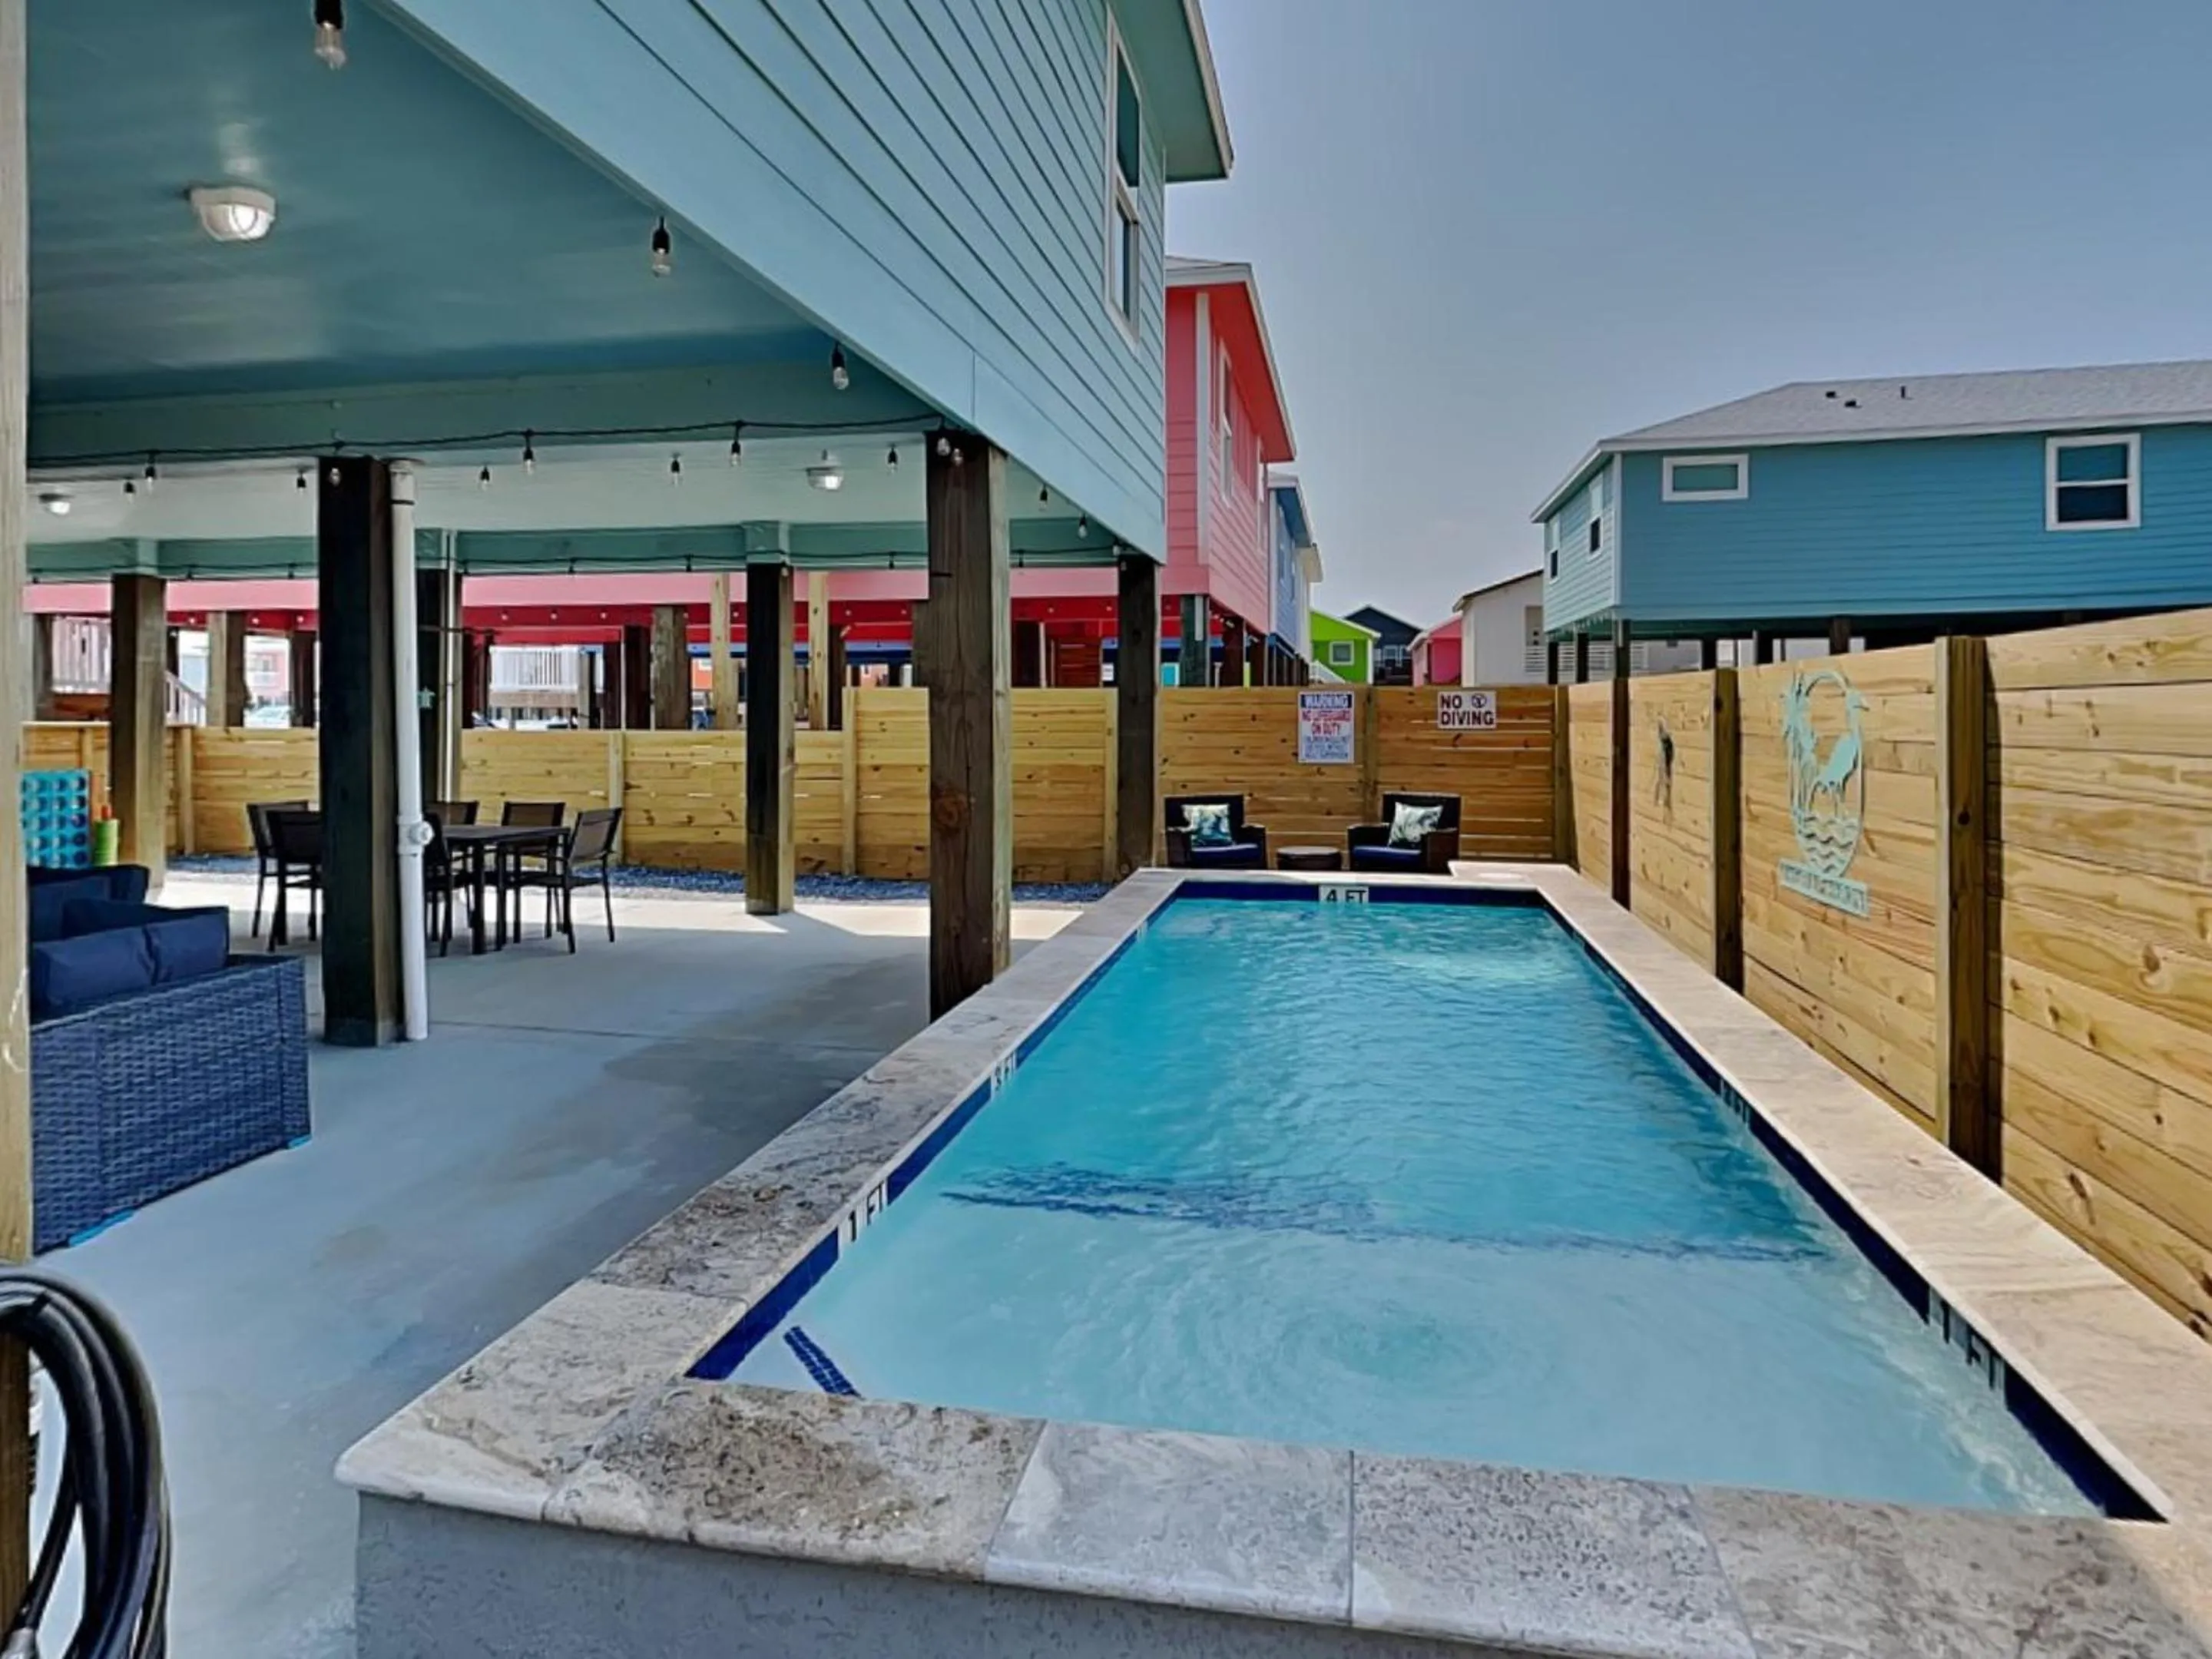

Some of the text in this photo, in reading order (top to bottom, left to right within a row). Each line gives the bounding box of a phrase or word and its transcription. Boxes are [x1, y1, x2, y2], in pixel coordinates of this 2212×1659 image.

[1441, 694, 1462, 709] NO
[1441, 710, 1495, 726] DIVING
[1326, 889, 1368, 903] 4 FT
[848, 1180, 884, 1243] 1 FT
[1965, 1322, 2000, 1391] FT
